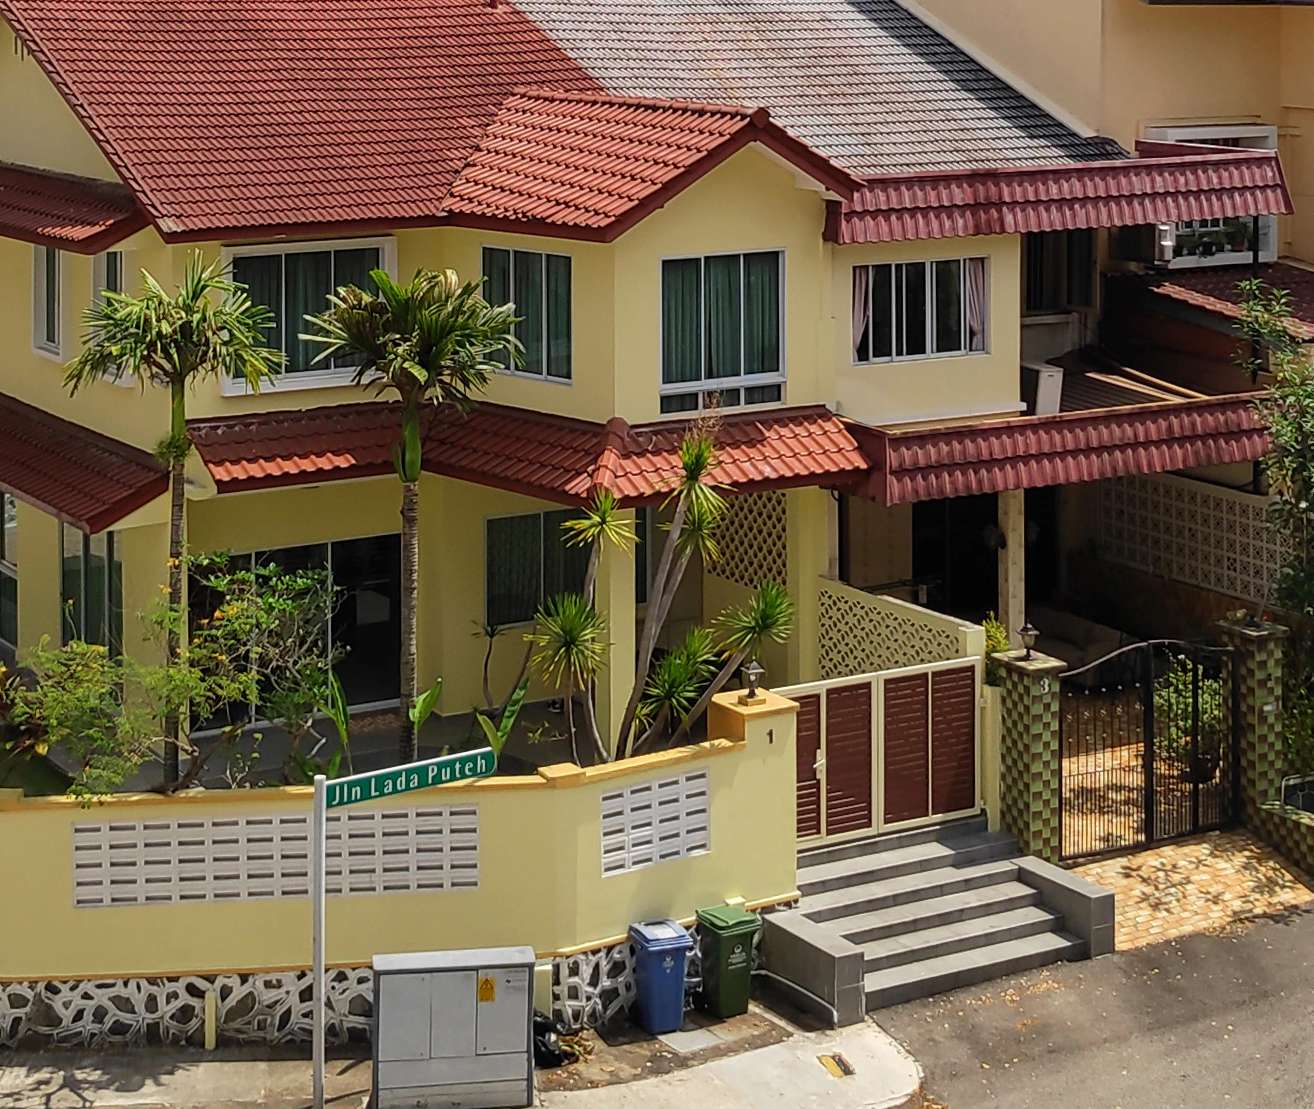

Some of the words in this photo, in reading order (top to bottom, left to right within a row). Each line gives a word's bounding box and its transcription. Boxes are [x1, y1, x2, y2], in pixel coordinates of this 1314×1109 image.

[1040, 677, 1050, 694] 3
[766, 728, 774, 744] 1
[332, 783, 361, 806] Jln
[370, 771, 419, 797] Lada
[428, 755, 487, 784] Puteh
